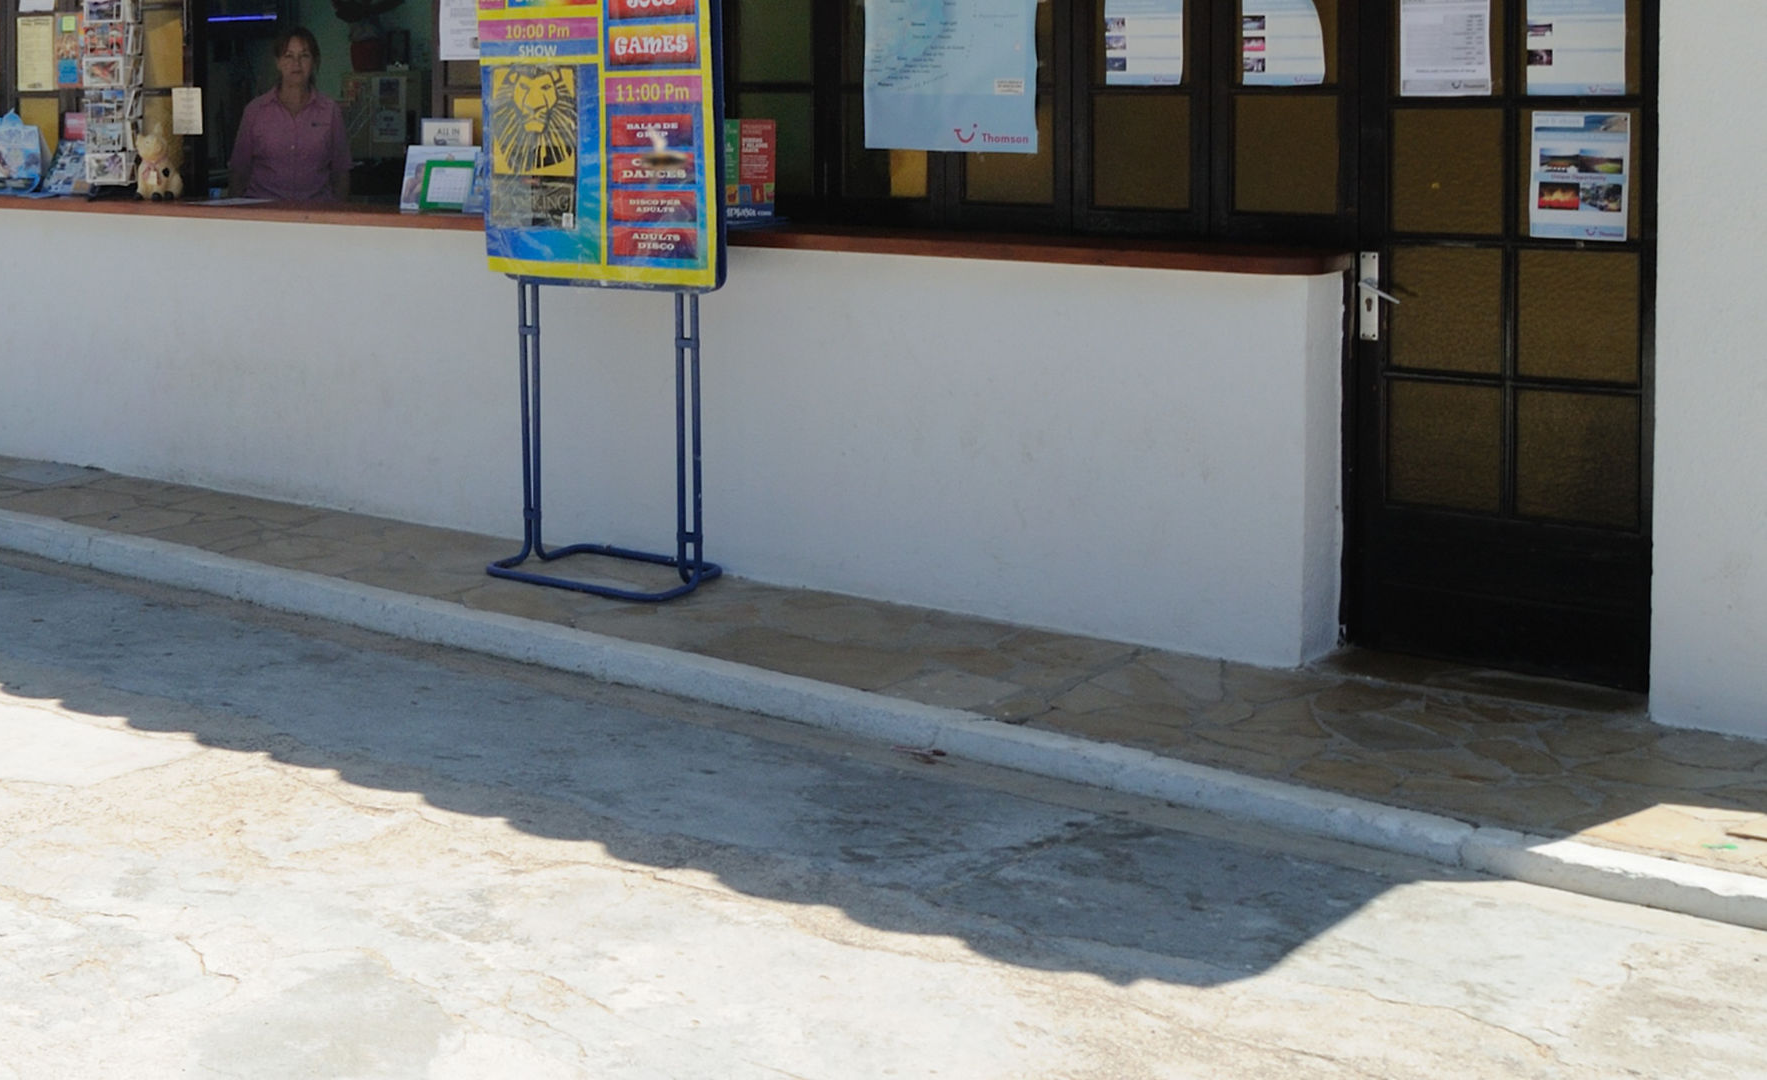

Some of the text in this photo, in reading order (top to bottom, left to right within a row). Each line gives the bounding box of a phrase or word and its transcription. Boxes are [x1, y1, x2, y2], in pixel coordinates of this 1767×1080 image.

[506, 23, 570, 39] 10:00 Pm
[614, 34, 688, 56] GAMES
[518, 45, 557, 57] SHOW
[615, 83, 690, 102] 11:00 Pm
[662, 122, 679, 130] DE
[982, 132, 1029, 144] Thomson
[622, 169, 687, 179] DANCES
[629, 198, 661, 206] DISCO
[632, 233, 681, 242] ADULTS
[637, 242, 675, 251] DISCO
